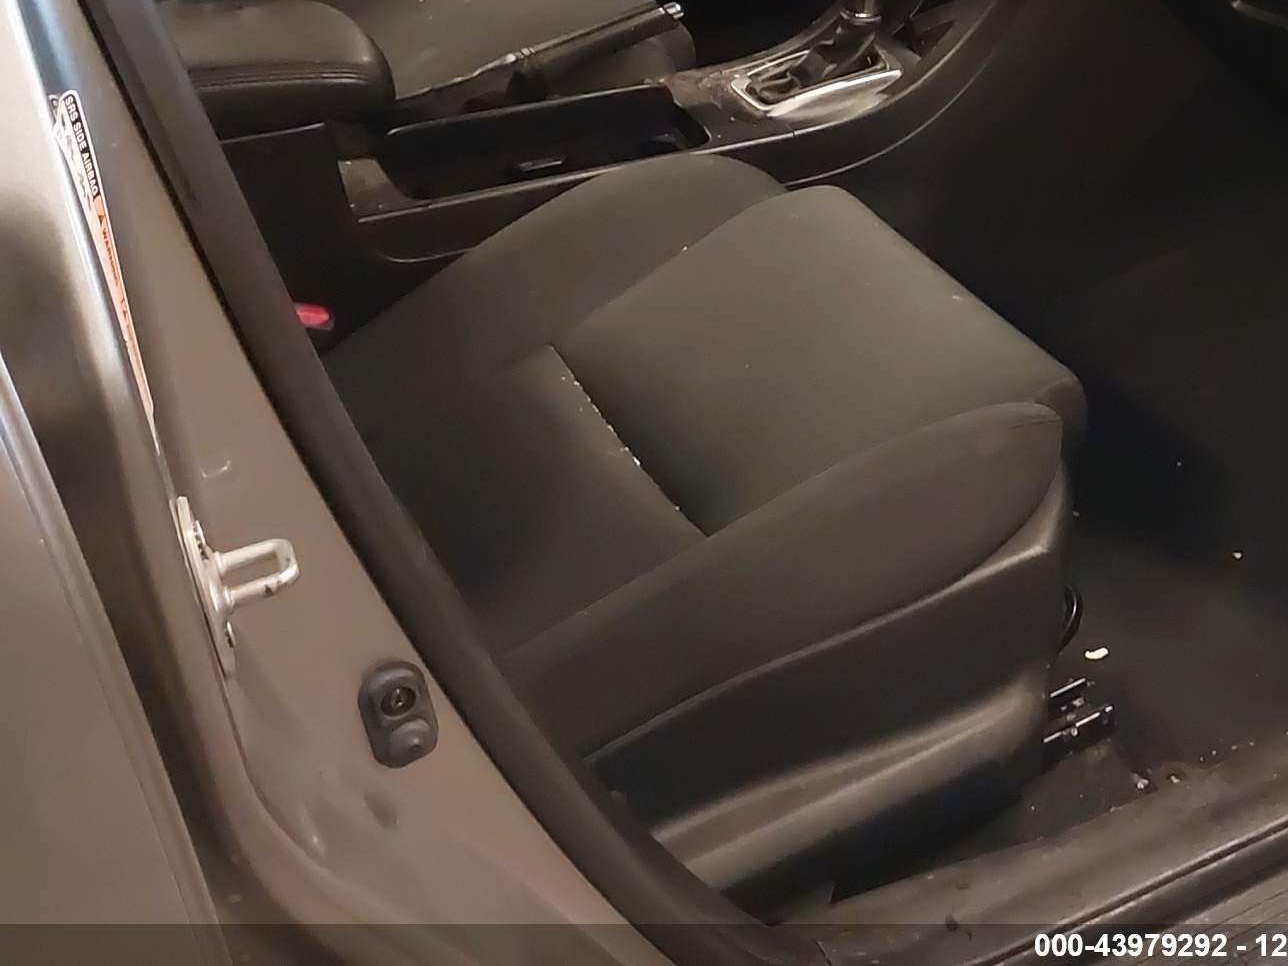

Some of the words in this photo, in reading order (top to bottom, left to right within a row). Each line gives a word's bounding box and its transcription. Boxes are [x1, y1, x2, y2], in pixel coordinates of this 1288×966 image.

[65, 95, 80, 121] SRS
[73, 122, 88, 152] SIDE
[81, 152, 99, 196] AIRBAG
